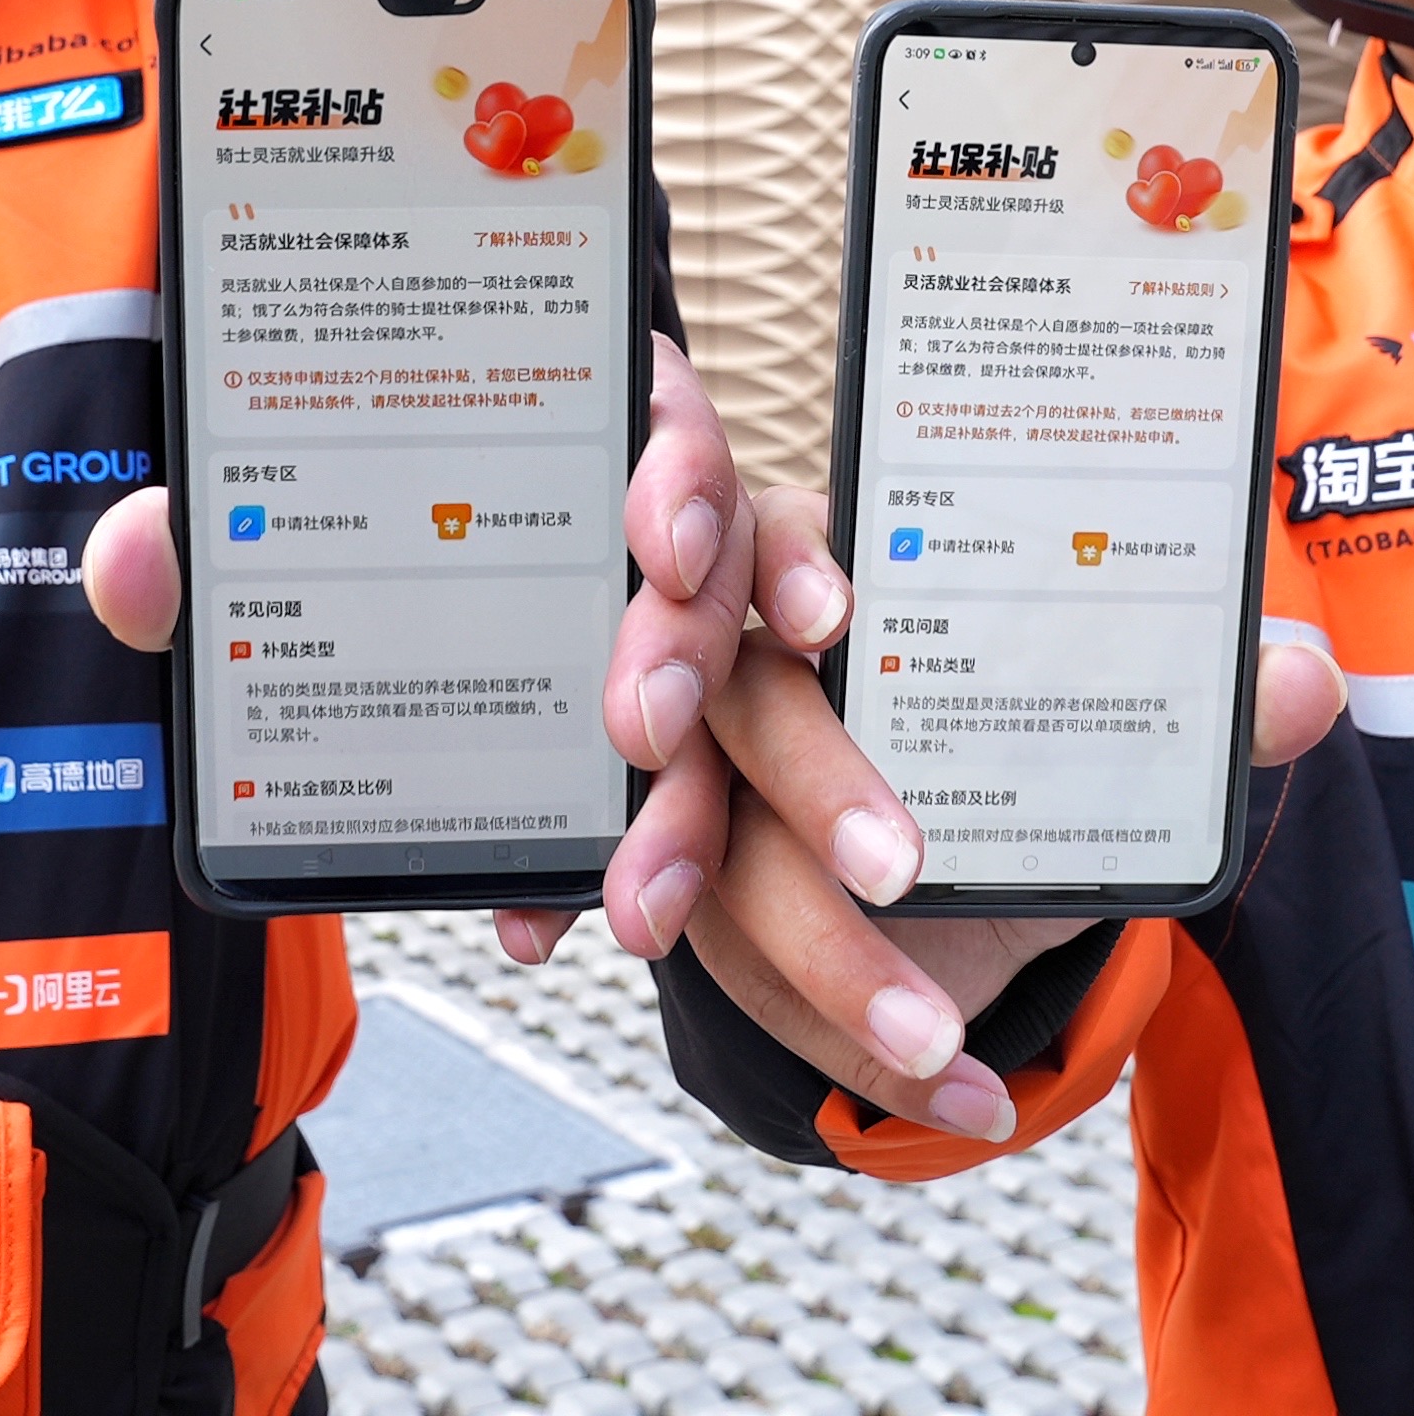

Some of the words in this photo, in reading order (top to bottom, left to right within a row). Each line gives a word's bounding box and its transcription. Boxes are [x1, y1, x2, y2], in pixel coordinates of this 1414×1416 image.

[905, 47, 931, 60] 3:09
[218, 87, 385, 127] 社保补贴
[216, 145, 396, 164] 骑士灵活就业保障升级
[910, 140, 1059, 180] 社保补贴
[906, 194, 1065, 215] 骑士灵活就业保障升级
[220, 231, 410, 252] 灵活就业社会保障体系
[473, 230, 572, 248] 了解补贴规则
[220, 274, 575, 294] 灵活就业人员社保是个人自愿参加的一项社会保障政
[902, 273, 1072, 295] 灵活就业社会保障体系
[1128, 280, 1214, 298] 了解补贴规则
[221, 326, 445, 344] 士参保缴费，提升社会保障水平。
[900, 315, 1214, 336] 灵活就业人员社保是个人自愿参加的一项社会保障政
[247, 366, 593, 388] 仅支持申请过去2个月的社保补贴，若您已缴纳社保
[897, 360, 1096, 381] 士参保缴费，提升社会保障水平。
[247, 392, 546, 411] 且满足补贴条件，请尽快发起社保补贴申请。
[917, 402, 1224, 423] 仅支持申请过去2个月的社保补贴，若您已缴纳社保
[916, 426, 1180, 445] 且满足补贴条件，请尽快发起社保补贴申请。
[21, 449, 151, 484] GROUP
[222, 465, 298, 484] 服务专区
[887, 490, 955, 507] 服务专区
[271, 514, 369, 532] 申请社保补贴
[475, 511, 573, 529] 补贴申请记录
[927, 538, 1015, 555] 申请社保补贴
[1110, 541, 1197, 558] 补贴申请记录
[228, 600, 303, 618] 常见问题
[882, 617, 950, 635] 常见问题
[261, 640, 336, 659] 补贴类型
[909, 656, 976, 674] 补贴类型
[246, 677, 553, 698] 补贴的类型是灵活就业的养老保险和医疗保
[247, 700, 569, 721] 险，视具体地方政策看是否可以单项缴纳，也
[892, 695, 1167, 712] 补贴的类型是灵活就业的养老保险和医疗保
[247, 727, 320, 744] 可以累计。
[890, 717, 1180, 734] 险，视具体地方政策看是否可以单项缴纳，也
[890, 739, 955, 754] 可以累计。
[20, 758, 144, 794] 高德地图
[265, 778, 393, 798] 补贴金额及比例
[900, 789, 1017, 807] 补贴金额及比例
[249, 814, 568, 837] 补贴金额是按照对应参保地城市最低档位费用
[32, 968, 121, 1014] 阿里云
